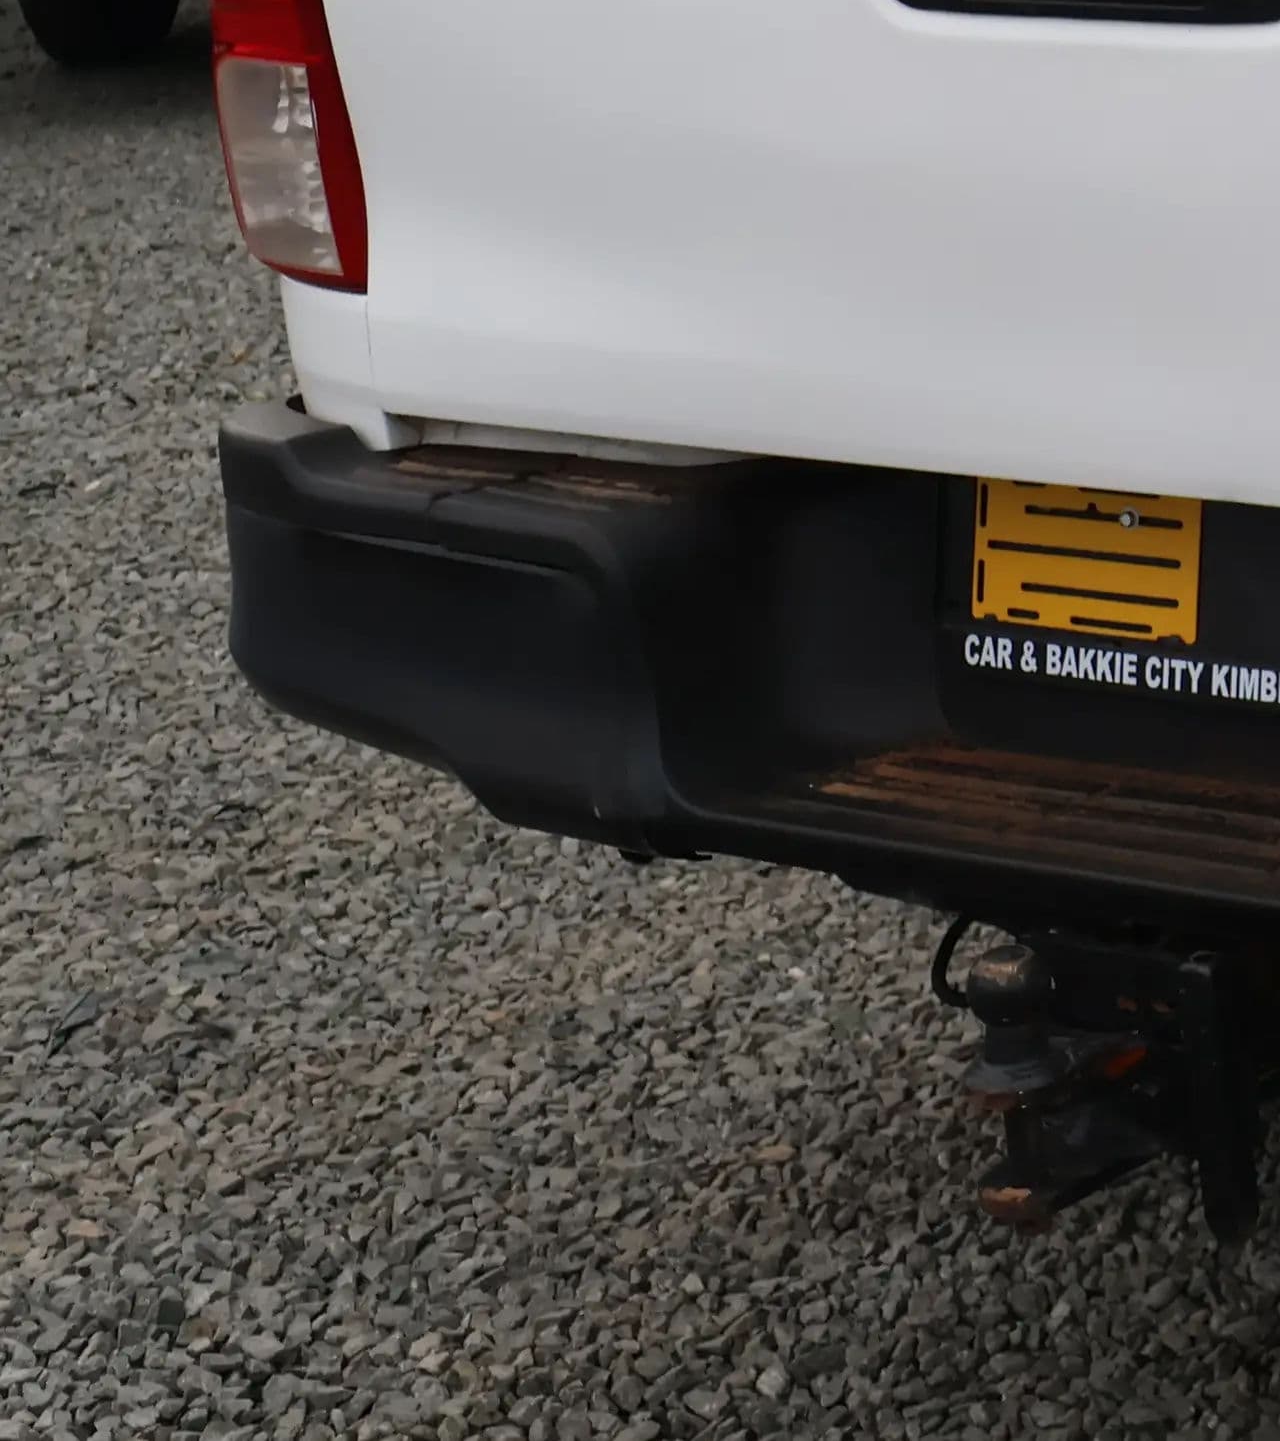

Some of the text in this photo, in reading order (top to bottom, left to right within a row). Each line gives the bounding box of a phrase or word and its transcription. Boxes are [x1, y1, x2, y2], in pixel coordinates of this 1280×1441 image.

[964, 633, 1013, 670] CAR
[1020, 639, 1038, 673] &
[1045, 643, 1138, 686] BAKKIE
[1144, 655, 1204, 694] CITY
